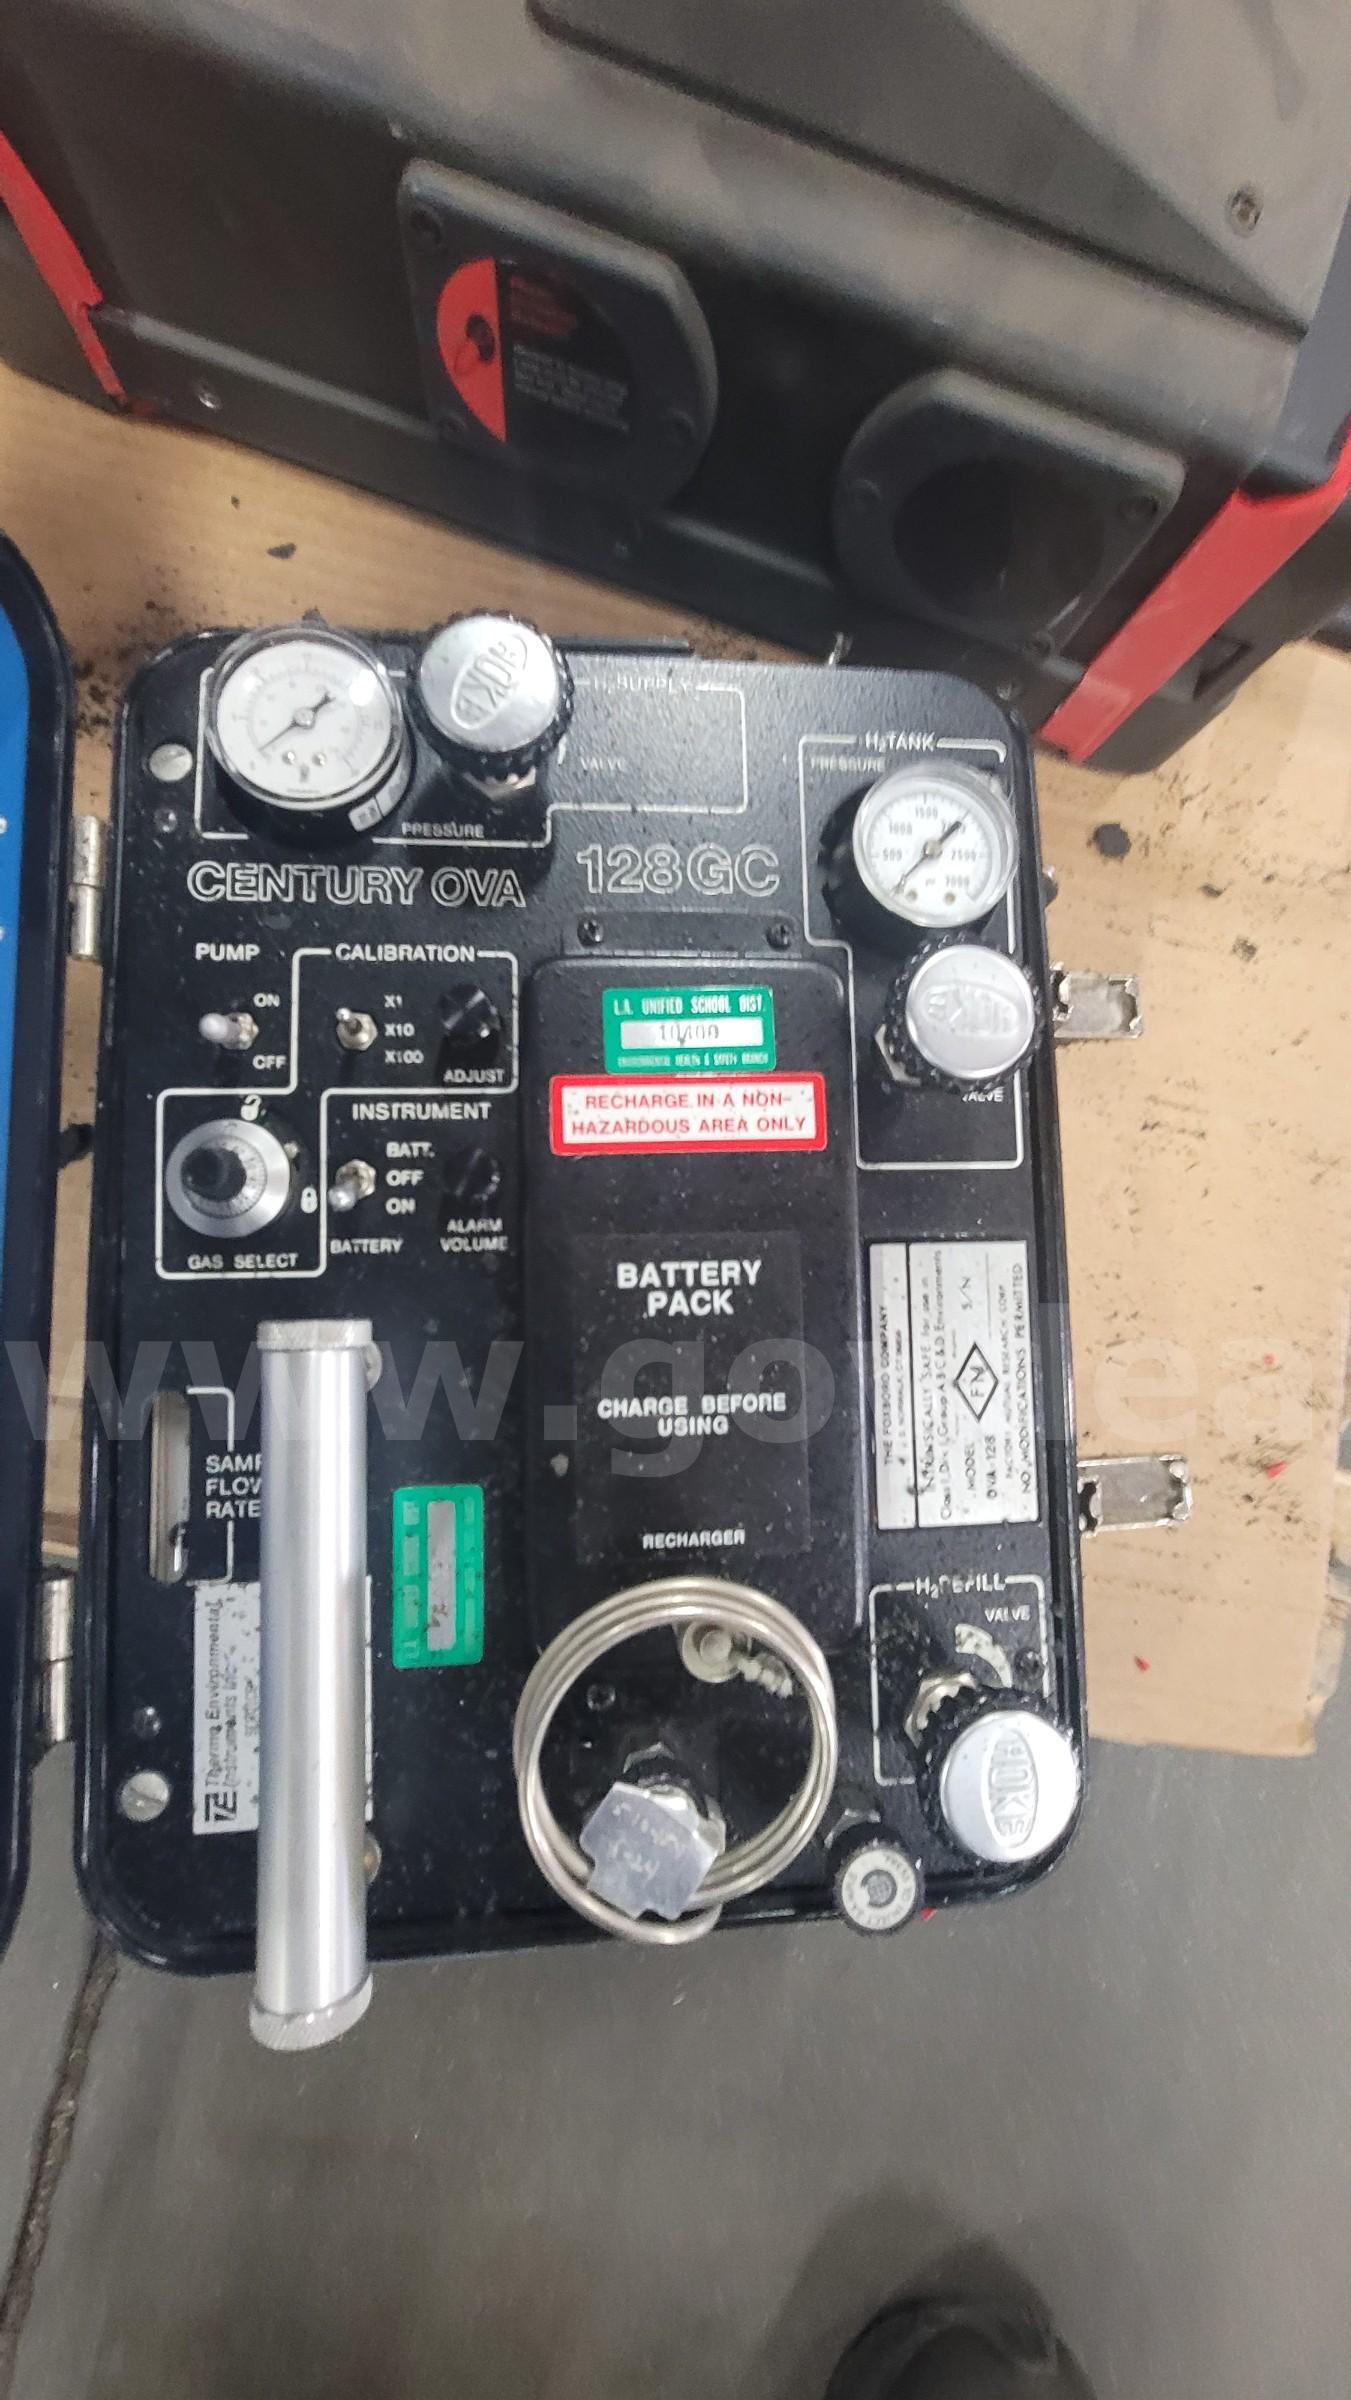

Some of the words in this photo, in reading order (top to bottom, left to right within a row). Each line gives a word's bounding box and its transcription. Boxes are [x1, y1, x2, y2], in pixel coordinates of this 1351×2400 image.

[401, 822, 485, 839] PRESSURE
[187, 860, 425, 906] CENTURY
[430, 866, 527, 908] OVA
[195, 942, 260, 961] PUMP
[335, 943, 476, 962] CALIBRATION
[253, 992, 280, 1007] ON
[384, 994, 403, 1008] X1
[641, 996, 683, 1015] UNIFIED
[690, 994, 732, 1014] SCHOOL
[384, 1022, 416, 1037] X10
[252, 1054, 287, 1070] OFF
[384, 1049, 424, 1064] X100
[443, 1068, 505, 1083] ADJUST
[585, 1091, 689, 1110] RECHARGE
[697, 1092, 714, 1108] IN
[723, 1092, 735, 1108] A
[742, 1091, 792, 1108] NON-
[352, 1102, 492, 1121] INSTRUMENT
[571, 1118, 690, 1136] HAZARDOUS
[699, 1117, 749, 1134] AREA
[757, 1115, 806, 1132] ONLY
[385, 1141, 436, 1158] BATT.
[385, 1169, 424, 1187] OFF
[385, 1197, 417, 1215] ON
[447, 1217, 503, 1234] ALARM
[330, 1237, 404, 1255] BATTERY
[440, 1236, 509, 1253] VOLUME
[187, 1254, 223, 1270] GAS
[234, 1252, 299, 1269] SELECT
[617, 1259, 762, 1289] BATTERY
[647, 1288, 735, 1318] PACK
[1011, 1262, 1025, 1339] PERMITTED
[879, 1304, 889, 1369] COMPANY
[597, 1395, 688, 1419] CHARGE
[701, 1392, 786, 1416] BEFORE
[1015, 1346, 1031, 1462] MODIFICATIONS
[657, 1414, 729, 1437] USING
[882, 1440, 893, 1466] THE
[964, 1442, 976, 1491] MODEL
[1020, 1471, 1032, 1494] NO
[206, 1500, 262, 1519] RATE
[642, 1529, 746, 1550] RECHARGER
